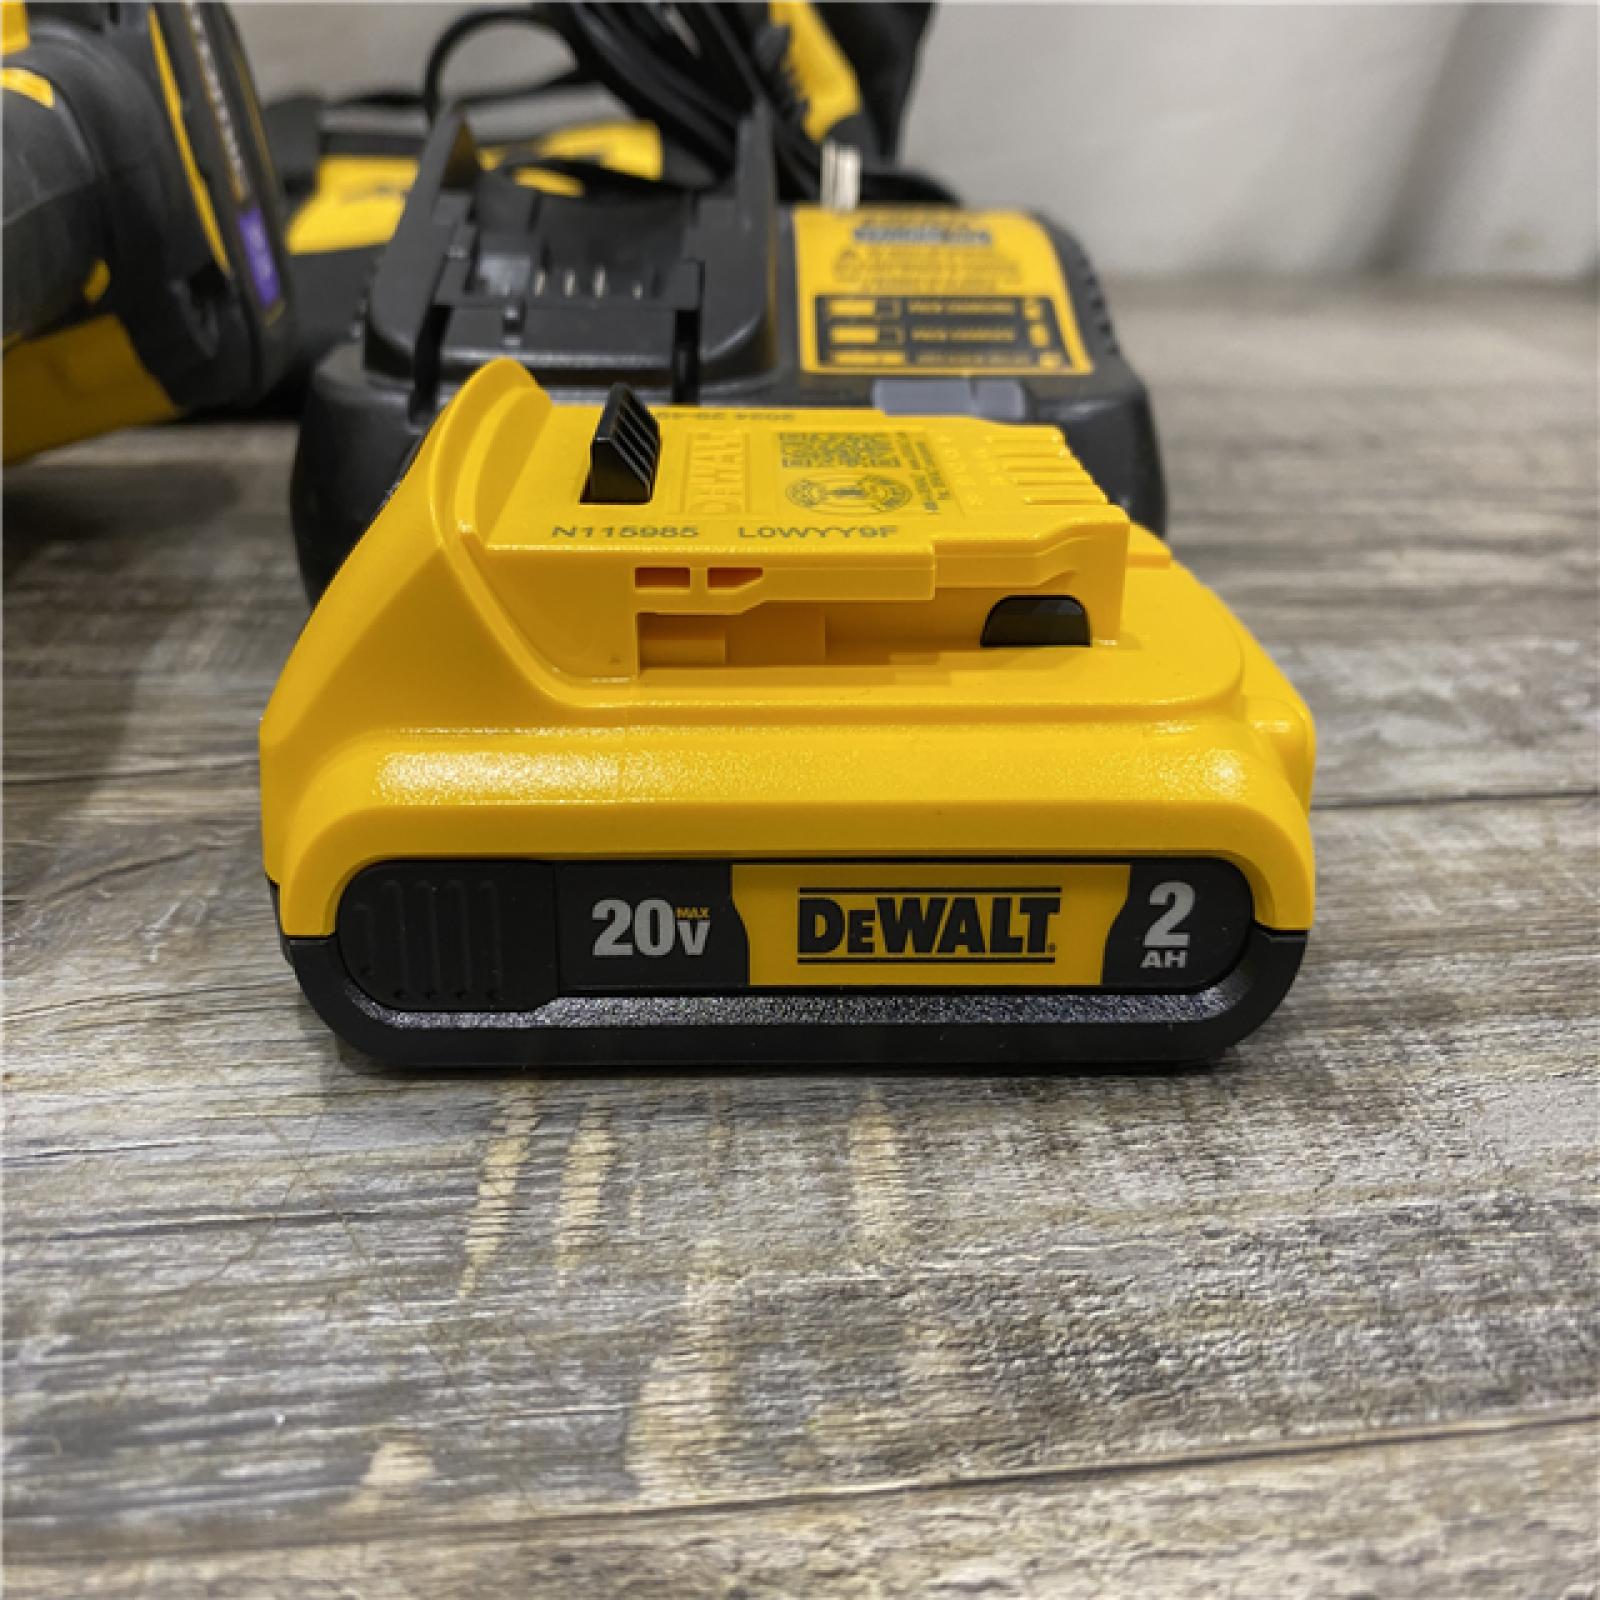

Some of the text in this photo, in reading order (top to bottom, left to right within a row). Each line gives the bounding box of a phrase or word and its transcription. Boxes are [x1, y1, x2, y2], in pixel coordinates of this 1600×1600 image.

[677, 907, 711, 919] MAX
[1143, 882, 1196, 948] 2
[1141, 950, 1187, 968] AH
